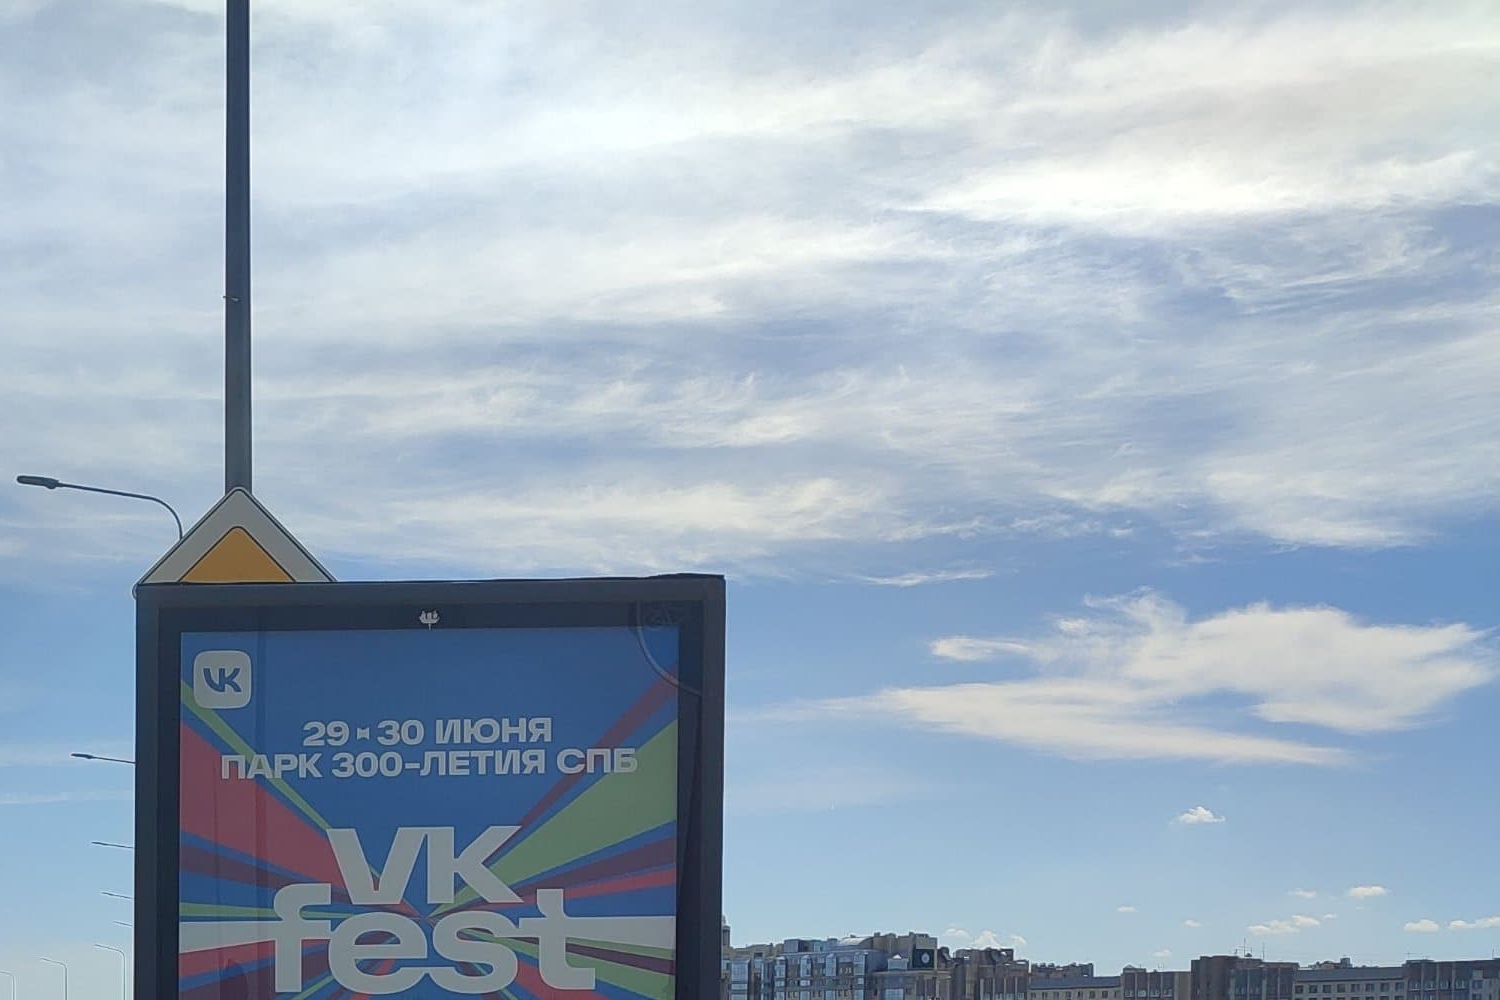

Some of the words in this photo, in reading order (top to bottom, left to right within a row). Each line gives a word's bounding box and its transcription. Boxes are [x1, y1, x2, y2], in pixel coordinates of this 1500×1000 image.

[203, 667, 242, 693] VK
[303, 720, 350, 747] 29
[377, 719, 425, 746] 30
[435, 717, 552, 745] ИЮНЯ
[221, 753, 323, 780] ПАРК
[332, 749, 546, 778] 300-ЛЕТИЯ
[556, 748, 638, 774] СПБ
[328, 825, 524, 905] VK
[273, 883, 596, 995] fest
